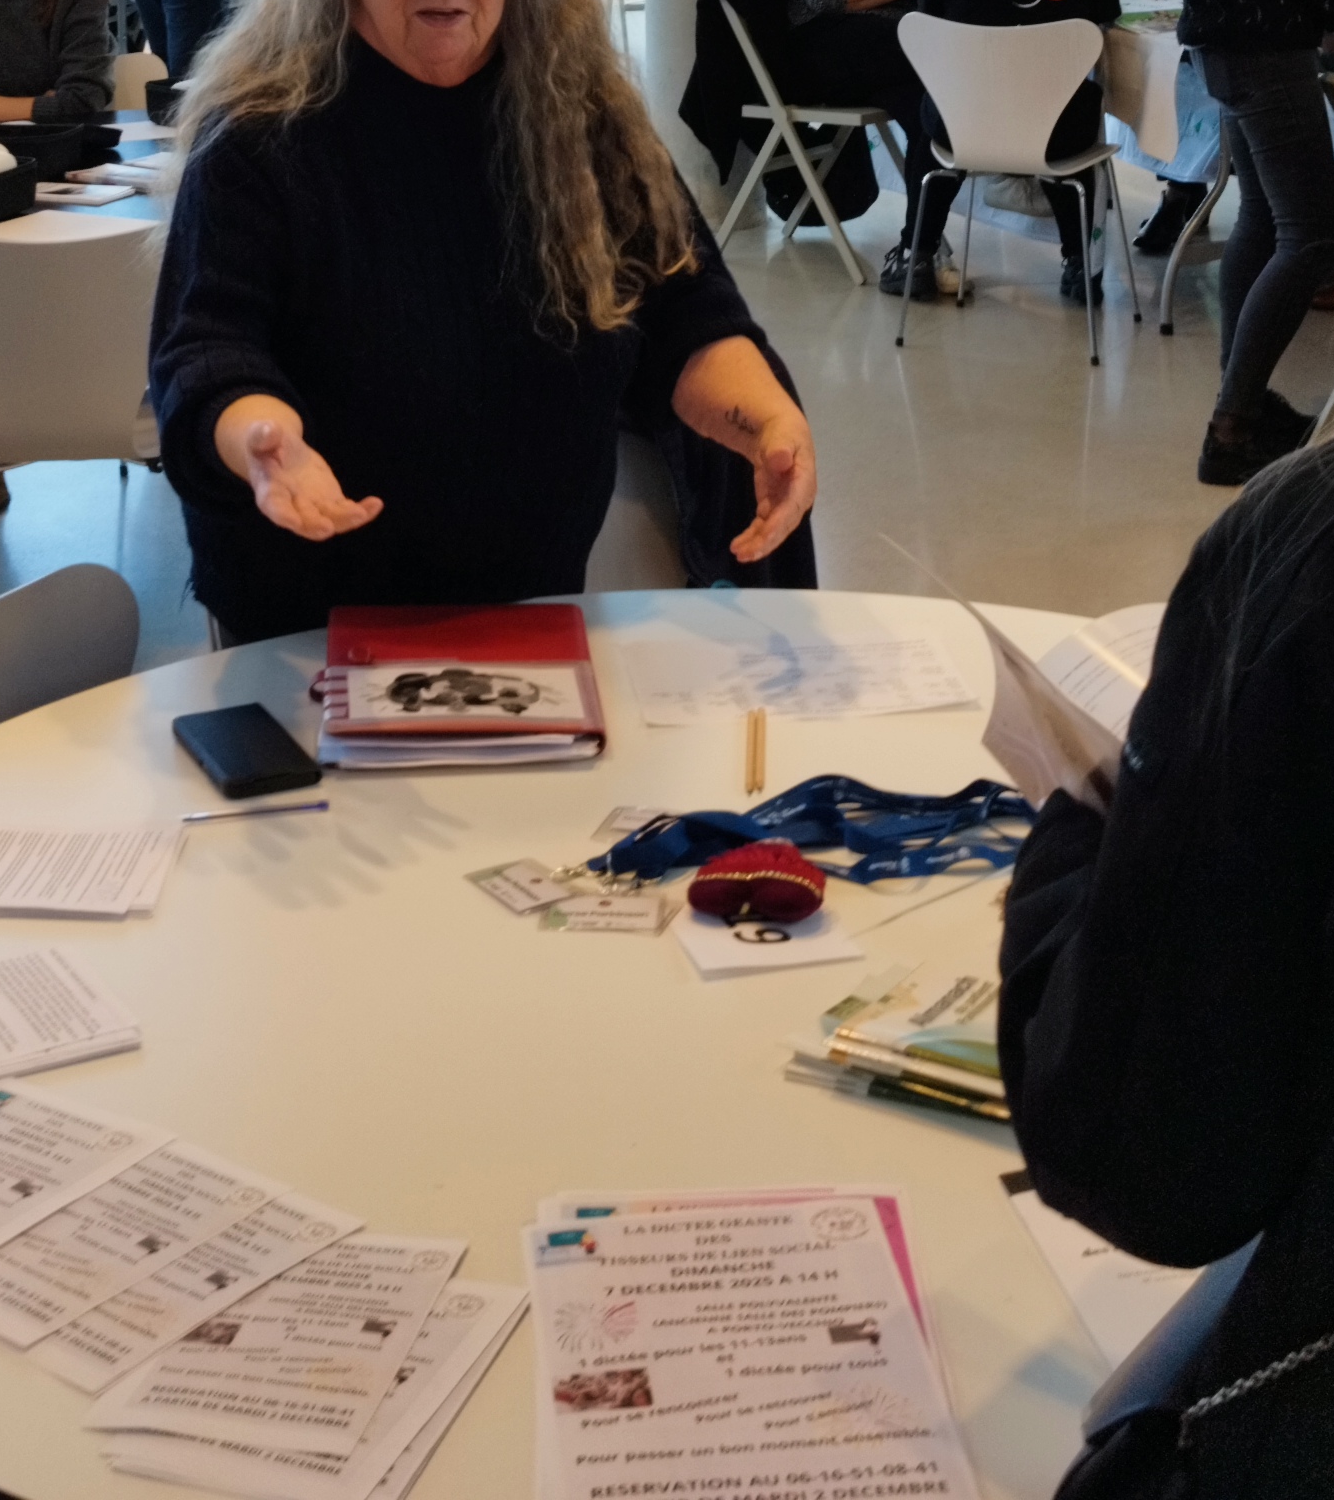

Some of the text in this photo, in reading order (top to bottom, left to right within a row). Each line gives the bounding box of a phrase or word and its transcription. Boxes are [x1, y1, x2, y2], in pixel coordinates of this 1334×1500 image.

[670, 1260, 774, 1277] DIMANCHE
[652, 1346, 694, 1361] pour
[800, 1361, 842, 1376] pour
[847, 1357, 889, 1371] tous
[690, 1447, 715, 1458] un
[719, 1443, 756, 1455] bon
[589, 1474, 744, 1499] RESERVATION
[749, 1473, 780, 1488] AU
[831, 1479, 949, 1500] DECEMBRE
